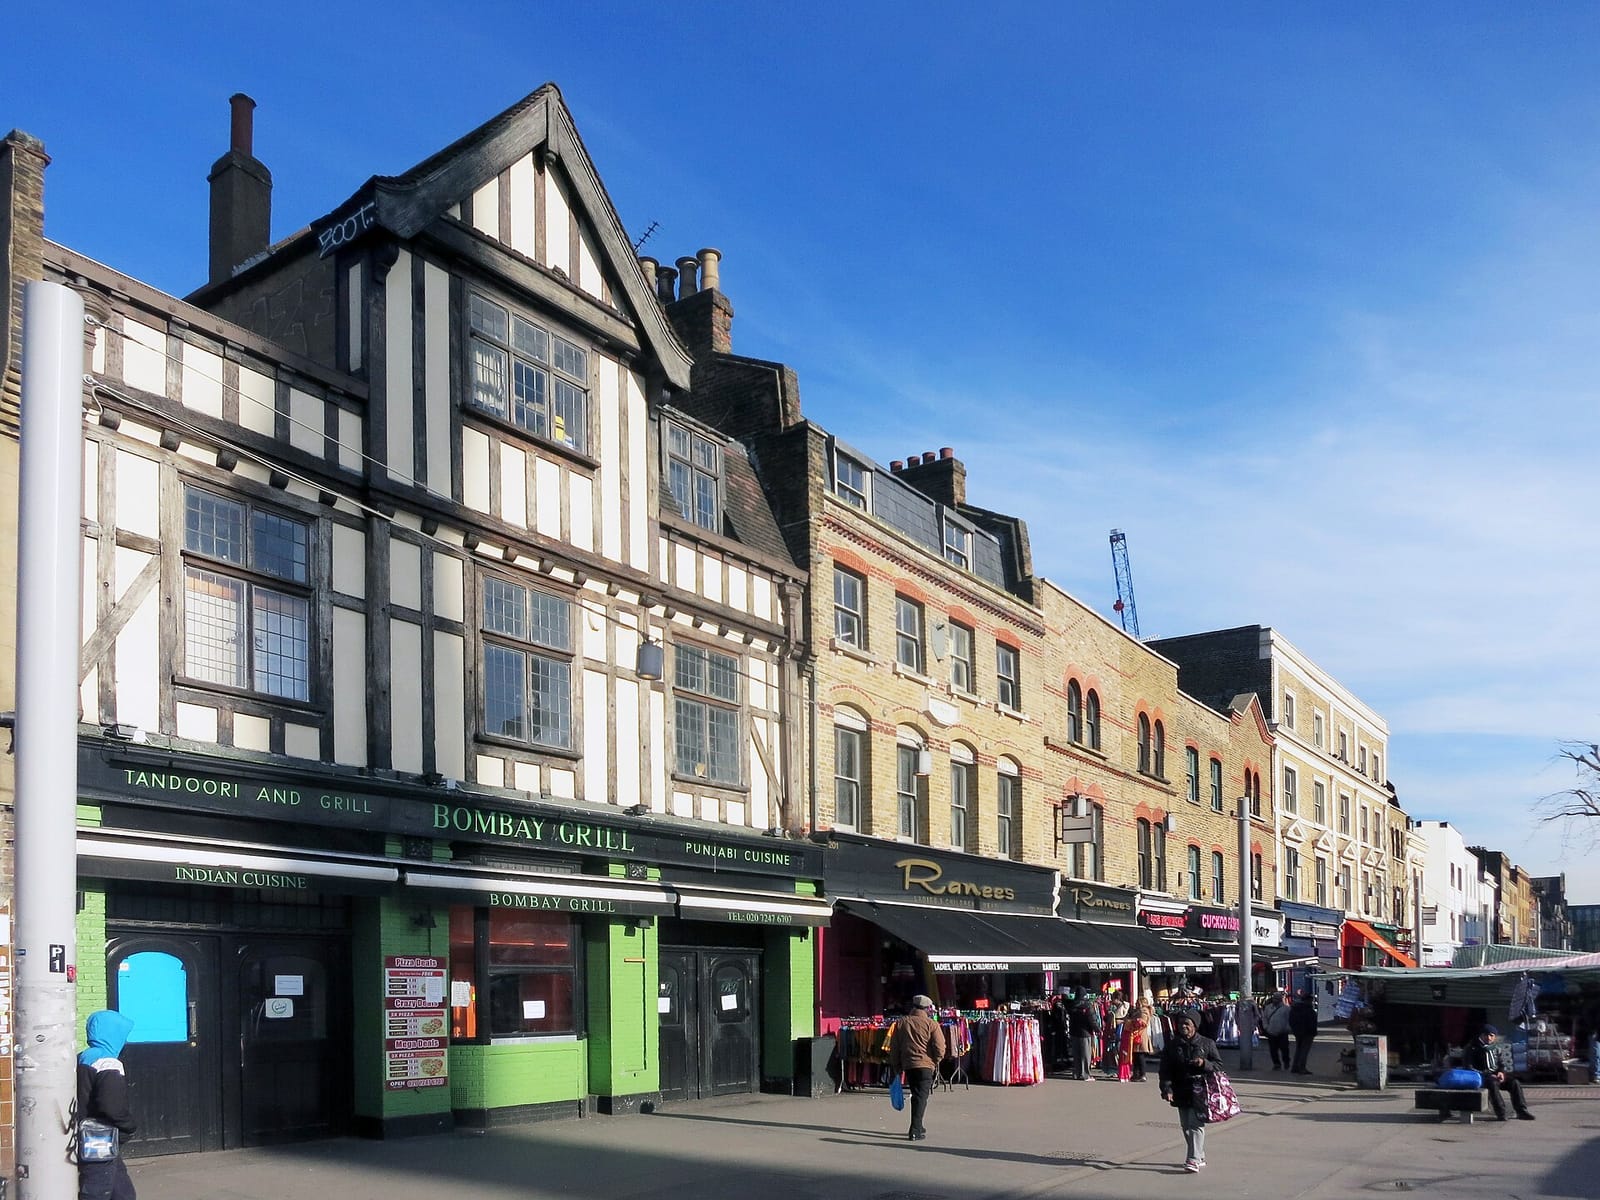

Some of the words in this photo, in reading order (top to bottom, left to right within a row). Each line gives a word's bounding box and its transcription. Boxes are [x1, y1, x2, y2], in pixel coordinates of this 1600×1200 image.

[124, 769, 239, 798] TANDOORI
[256, 786, 301, 806] AND
[320, 795, 372, 814] GRILL
[433, 803, 545, 841] BOMBAY
[559, 821, 635, 852] GRILL
[685, 842, 737, 859] PUNJABI
[744, 850, 790, 866] CUISINE
[175, 867, 238, 885] INDIAN
[242, 872, 307, 890] CUISINE
[896, 858, 1016, 901] Ranees
[489, 893, 561, 909] BOMBAY
[569, 898, 616, 913] GRILL
[1070, 887, 1131, 911] Ranees
[727, 911, 745, 922] TEL:
[746, 912, 759, 922] 020
[760, 913, 776, 923] 7247
[1202, 914, 1228, 930] CUCKOO
[52, 947, 63, 957] P
[53, 960, 60, 971] 1
[395, 957, 415, 967] Pizza
[415, 958, 438, 968] Deals
[395, 999, 417, 1009] Crazy
[395, 1039, 417, 1049] Mega
[417, 1039, 440, 1048] Deals
